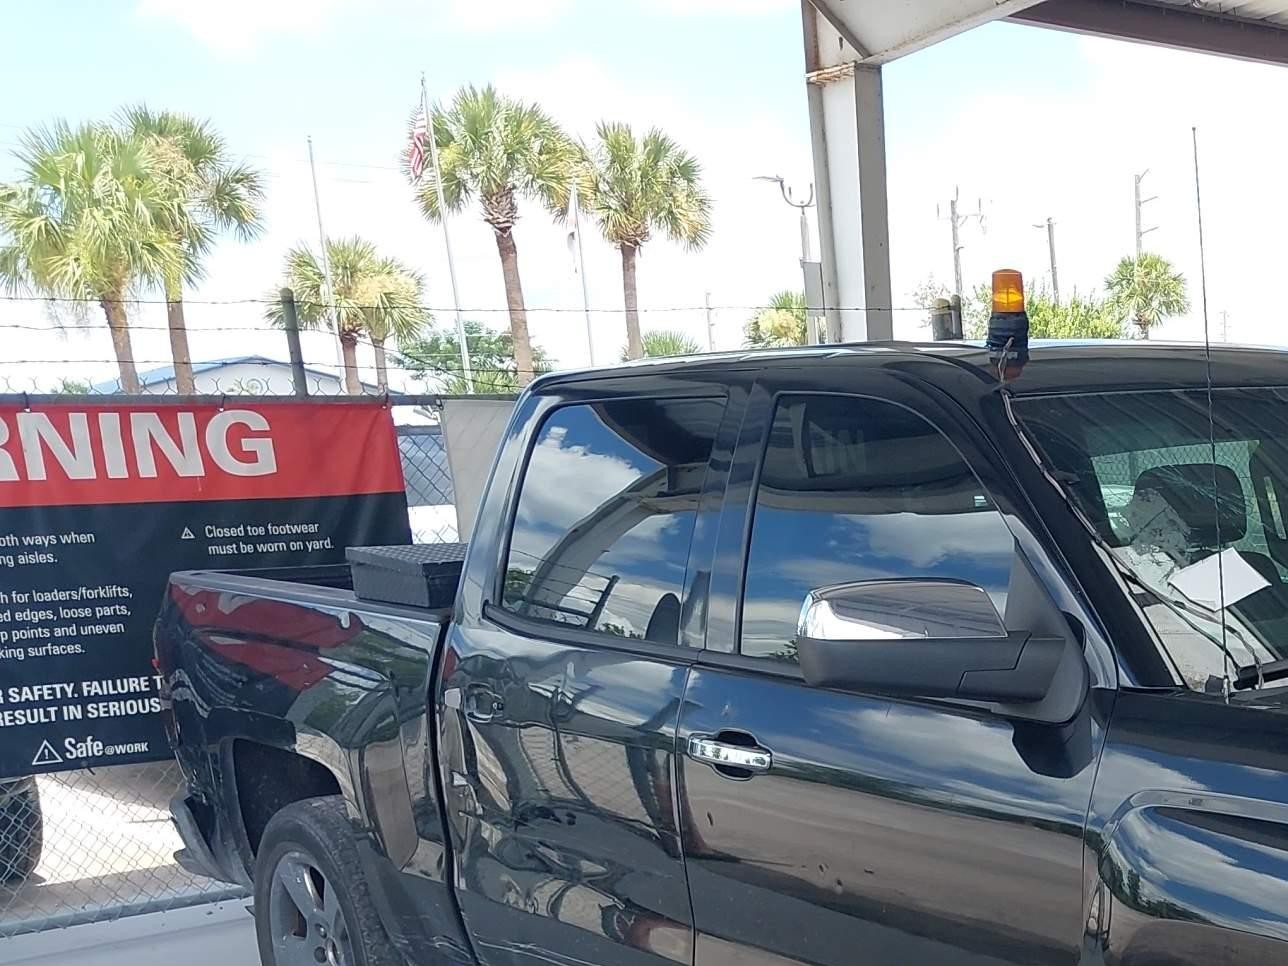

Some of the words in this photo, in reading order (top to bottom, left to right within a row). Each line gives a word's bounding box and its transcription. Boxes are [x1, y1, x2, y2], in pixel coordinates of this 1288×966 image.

[22, 535, 57, 547] ways
[60, 531, 95, 544] when
[205, 524, 244, 538] Closed
[247, 524, 265, 536] toe
[267, 522, 320, 535] footwear
[208, 543, 238, 556] must
[239, 541, 254, 553] be
[256, 542, 286, 552] worn
[289, 541, 304, 551] on
[305, 537, 335, 552] yard.
[18, 551, 58, 564] aisles.
[11, 590, 30, 603] for
[33, 585, 133, 602] loaders/forklifts,
[15, 608, 57, 623] edges,
[59, 606, 93, 619] loose
[95, 604, 131, 619] parts,
[12, 626, 50, 642] points
[53, 624, 77, 637] and
[80, 623, 125, 635] uneven
[28, 643, 86, 657] surfaces.
[8, 683, 78, 703] SAFETY.
[82, 676, 150, 697] FAILURE
[63, 704, 83, 721] IN
[87, 697, 161, 718] SERIOUS
